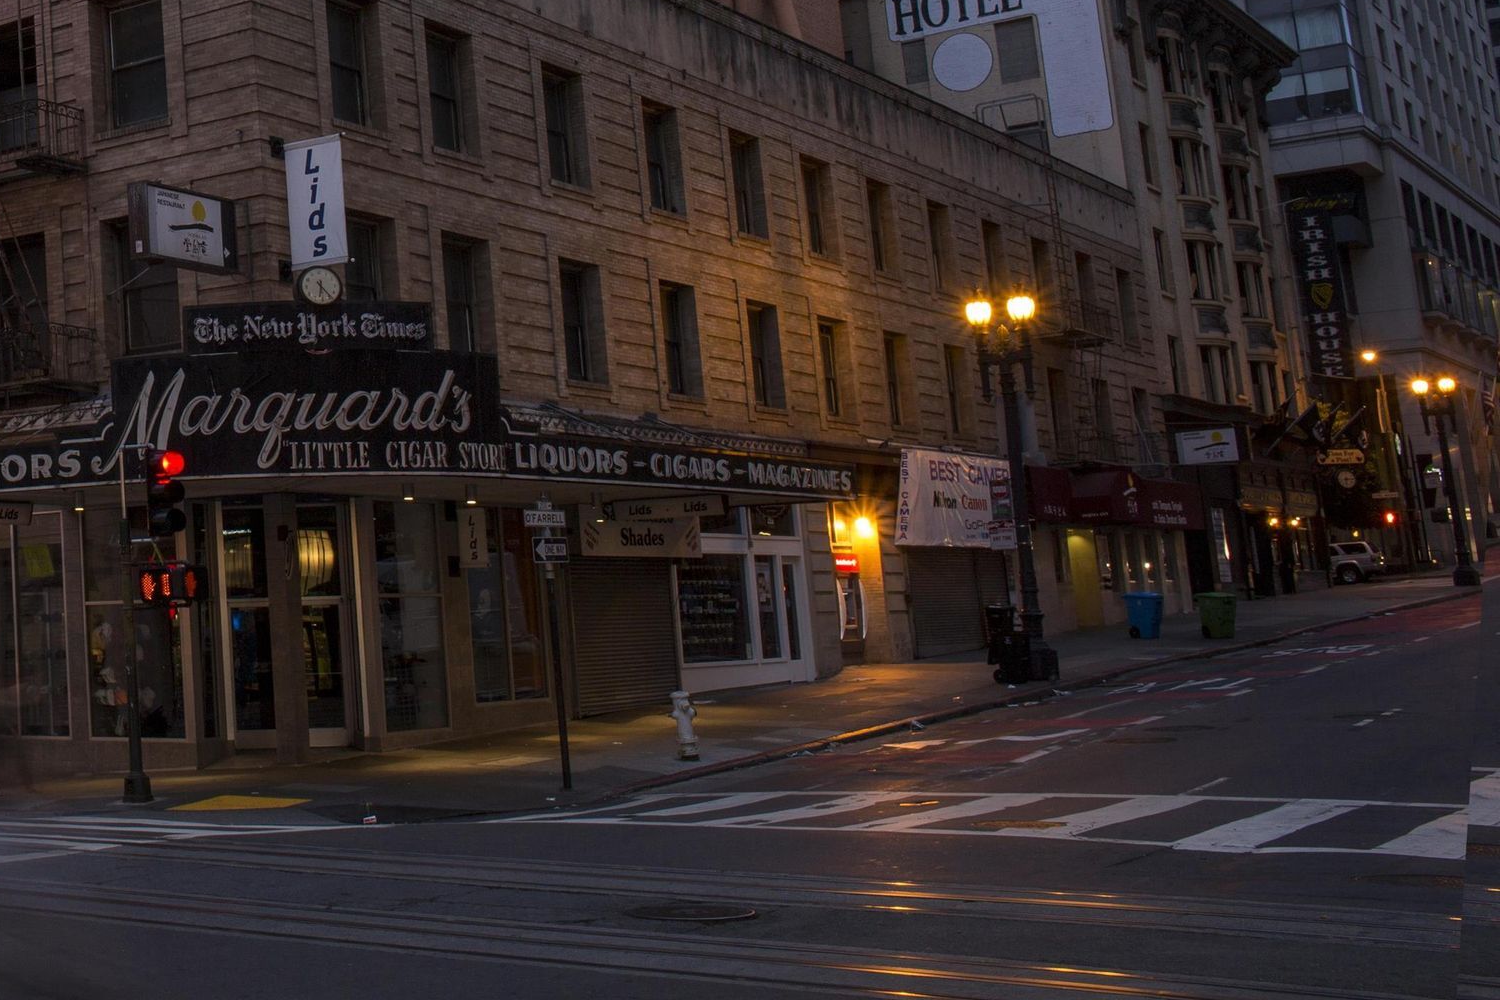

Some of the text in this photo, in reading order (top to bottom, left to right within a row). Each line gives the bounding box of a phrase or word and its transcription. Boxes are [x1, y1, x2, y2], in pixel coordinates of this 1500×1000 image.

[304, 149, 328, 257] Lids
[1299, 214, 1335, 281] IRISH
[194, 312, 427, 344] The New York Times
[1311, 311, 1345, 378] HOUSE
[90, 367, 472, 474] Marquard's
[385, 441, 448, 468] CIGAR
[515, 444, 628, 475] LIQUORS
[650, 452, 731, 482] CIGARS
[747, 461, 852, 492] MAGAZINES
[901, 453, 909, 484] BEST
[929, 460, 1010, 485] BEST CAMER
[525, 513, 564, 524] O'FARRELL
[629, 501, 708, 516] Lids Lids
[961, 495, 988, 511] Canon
[468, 515, 479, 560] Lids
[620, 528, 665, 546] Shades
[965, 520, 990, 530] GoPr
